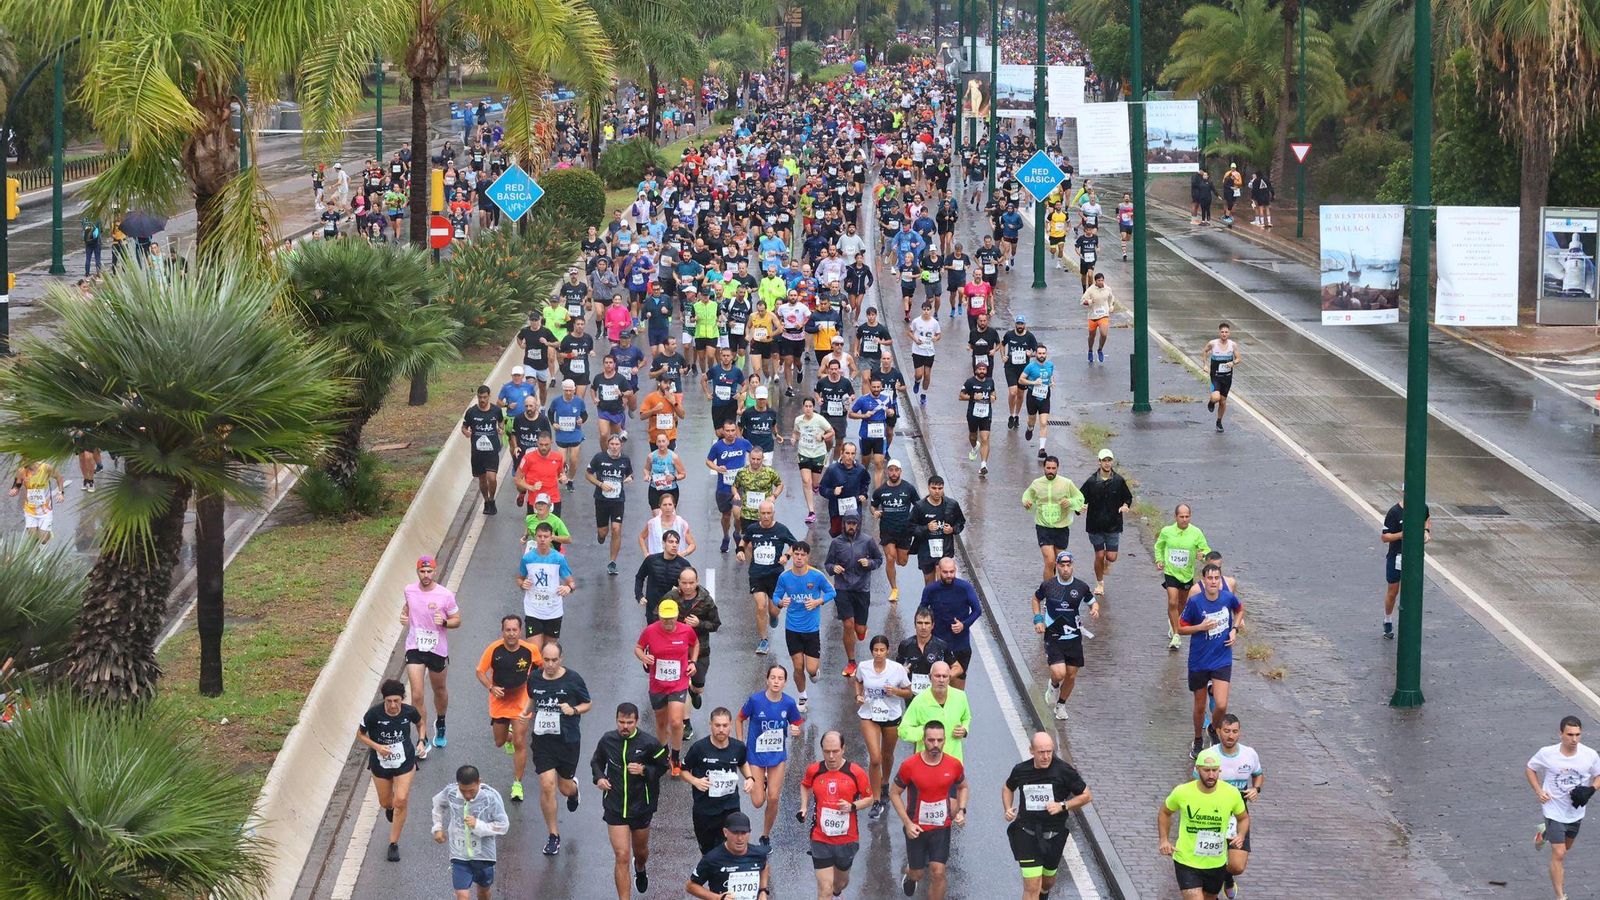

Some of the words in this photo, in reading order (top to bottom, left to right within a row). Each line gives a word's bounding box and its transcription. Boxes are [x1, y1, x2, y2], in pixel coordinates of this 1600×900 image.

[1031, 167, 1049, 175] RED
[504, 183, 524, 191] RED
[1334, 212, 1400, 220] WESTMORLAND
[1334, 223, 1370, 233] MÁLAGA
[761, 720, 785, 730] RCM
[759, 737, 782, 745] 11229
[1030, 794, 1050, 803] 3589
[925, 810, 945, 819] 1338
[1196, 814, 1223, 822] QUEDADA
[824, 819, 845, 828] 6967
[732, 883, 758, 892] 13703
